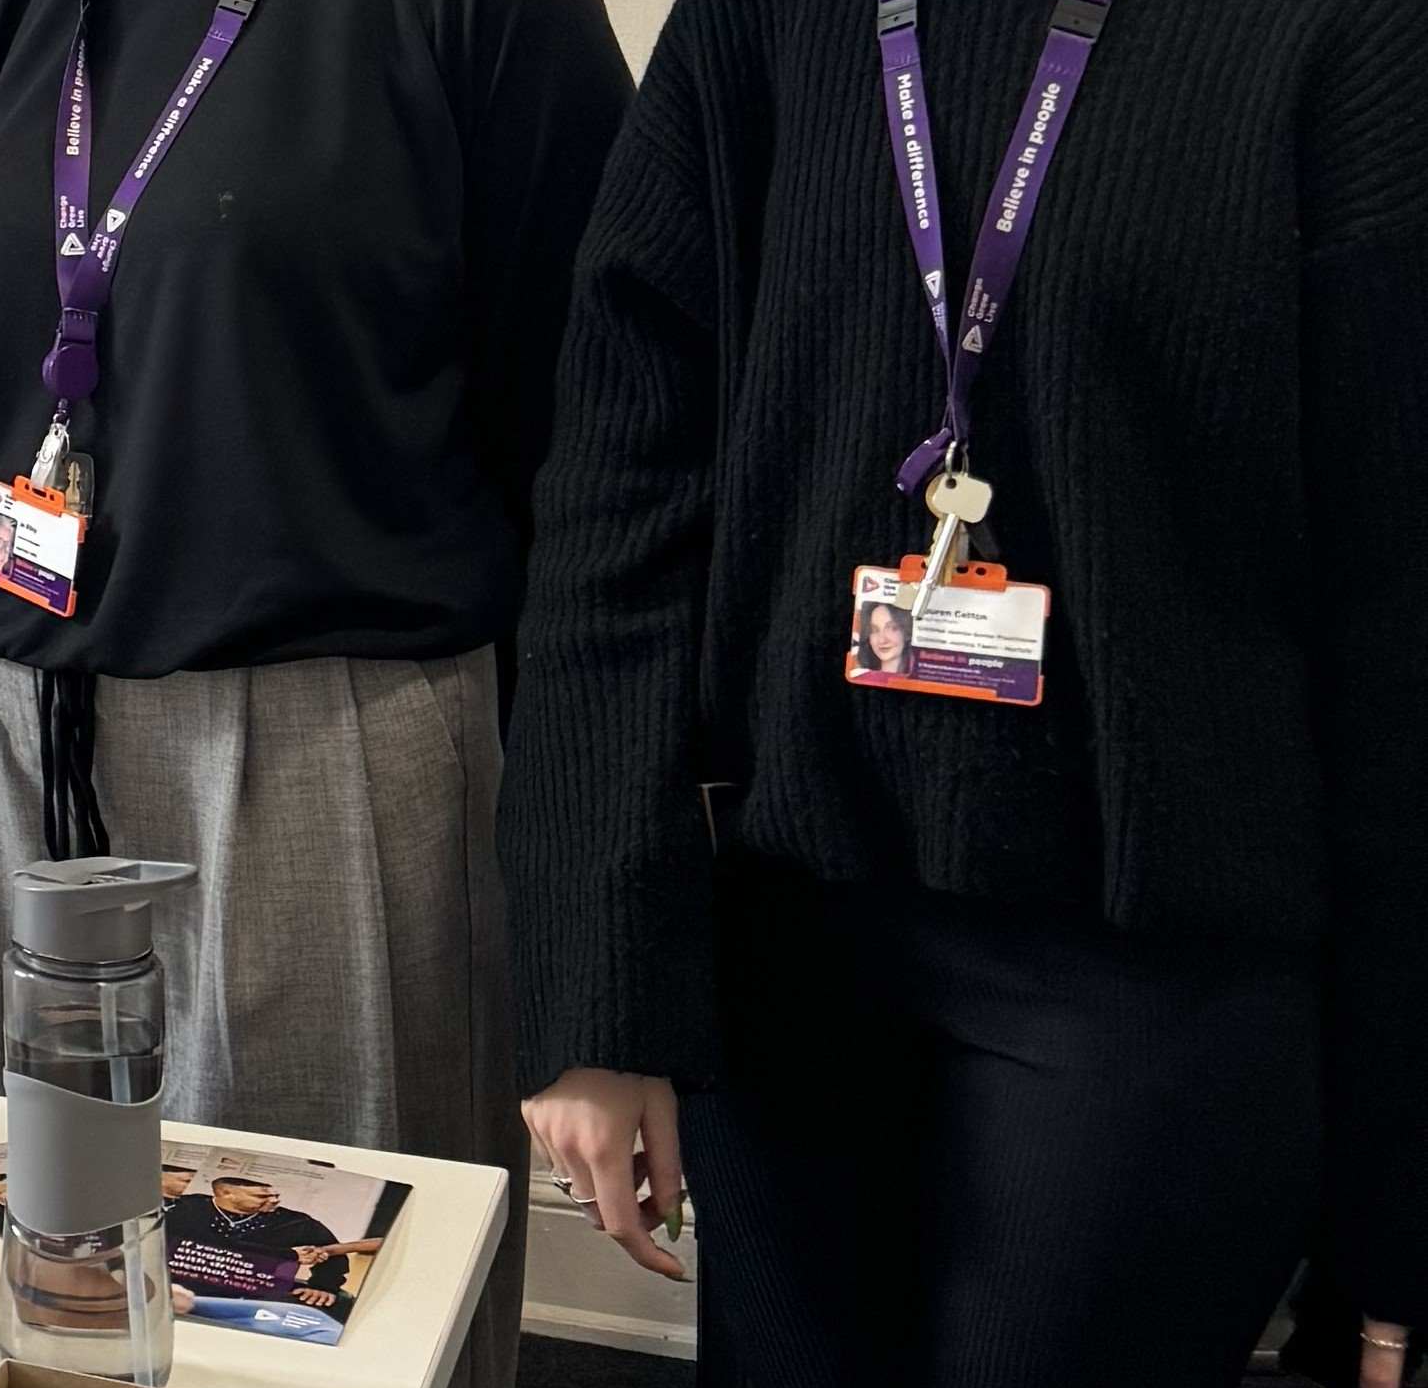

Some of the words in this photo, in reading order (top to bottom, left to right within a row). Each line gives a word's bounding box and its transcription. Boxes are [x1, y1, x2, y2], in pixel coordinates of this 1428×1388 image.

[71, 86, 82, 104] in
[185, 58, 213, 96] Make
[177, 96, 187, 109] a
[897, 73, 914, 121] Make
[66, 103, 81, 157] Believe
[132, 108, 181, 178] difference
[904, 124, 916, 136] a
[996, 168, 1029, 233] Believe
[1018, 146, 1037, 165] in
[1029, 82, 1061, 145] people
[906, 139, 930, 230] difference
[173, 1253, 206, 1265] with
[209, 1259, 255, 1276] drugs
[256, 1272, 275, 1280] or
[176, 1247, 255, 1270] struggling
